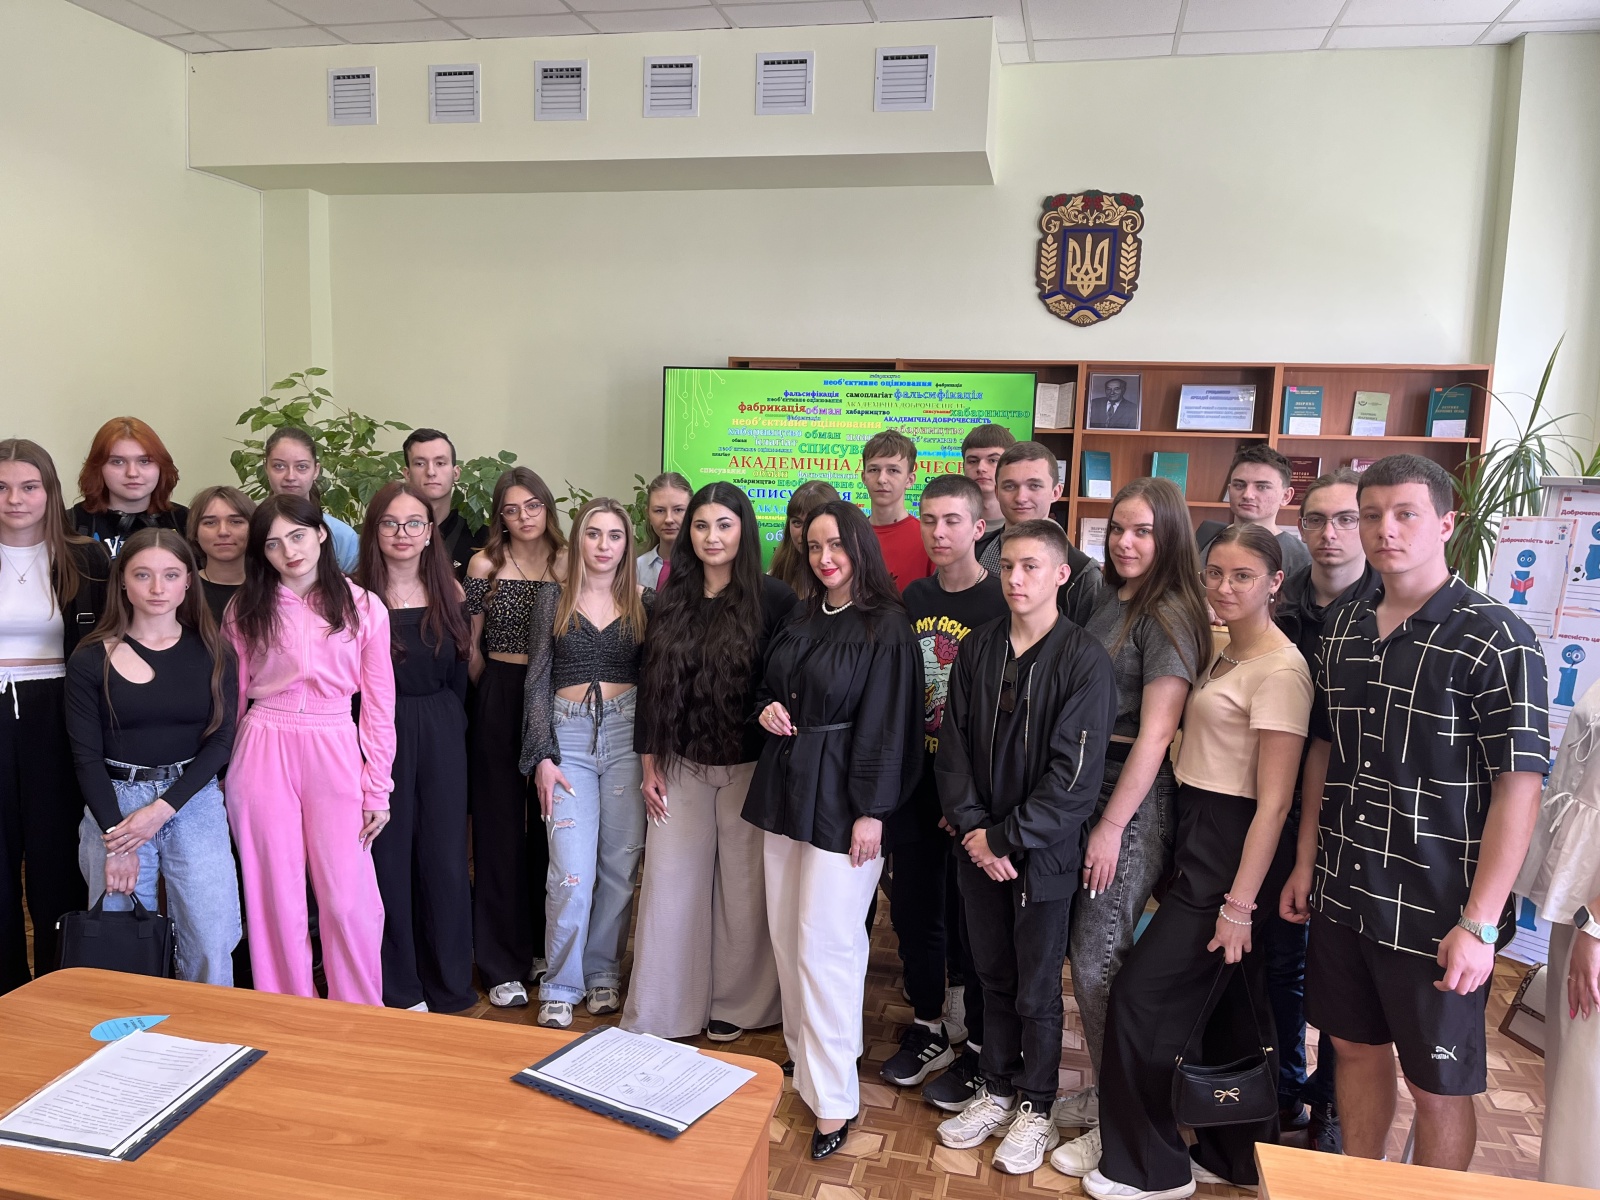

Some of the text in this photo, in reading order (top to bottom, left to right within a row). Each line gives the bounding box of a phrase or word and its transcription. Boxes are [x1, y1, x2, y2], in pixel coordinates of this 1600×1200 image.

[784, 390, 840, 399] фальсифікація
[894, 388, 984, 401] фальсифікація
[738, 402, 806, 414] фабрикація
[806, 406, 842, 415] обман
[950, 407, 1031, 419] хабарництво
[810, 418, 882, 429] оцінювання
[728, 427, 802, 438] хабарництво
[804, 430, 842, 439] обман
[798, 442, 865, 458] списува
[728, 456, 851, 471] АКАДЕМІЧНА
[752, 470, 788, 478] обман
[916, 616, 937, 634] MY
